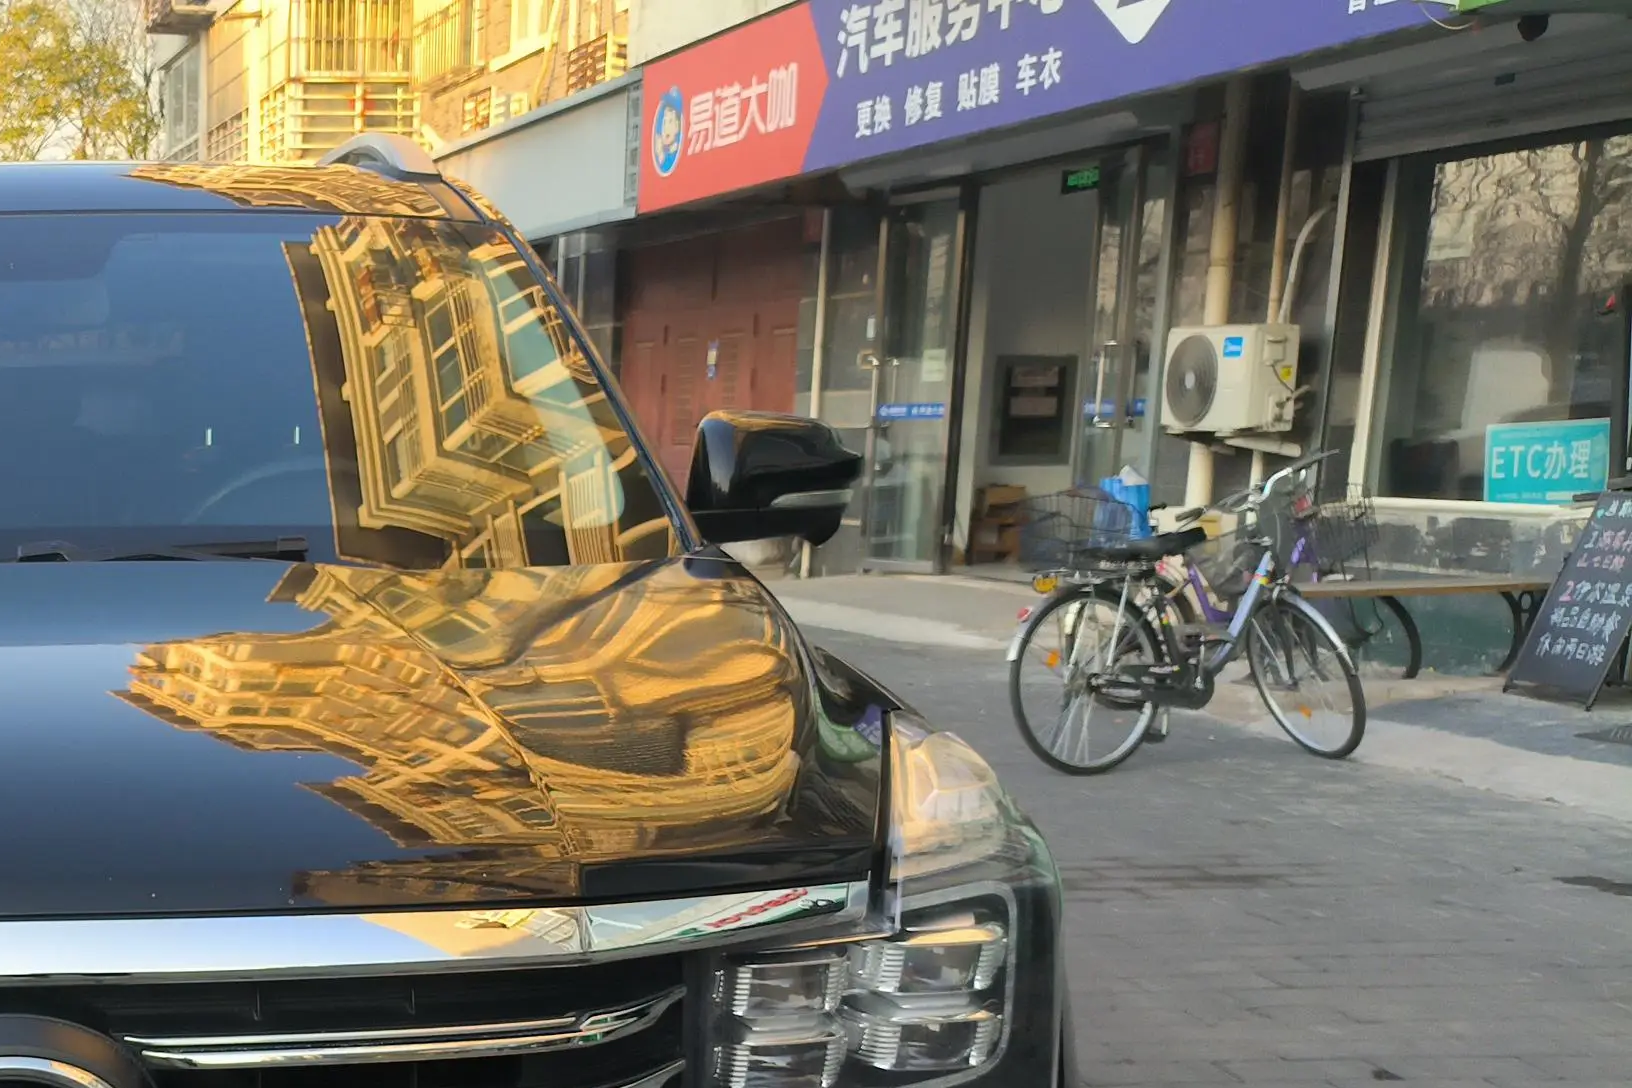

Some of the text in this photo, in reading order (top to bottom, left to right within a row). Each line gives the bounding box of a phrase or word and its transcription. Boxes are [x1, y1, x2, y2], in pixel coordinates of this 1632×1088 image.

[687, 61, 799, 155] 易道大咖
[855, 46, 1063, 138] 更换 修复 贴膜 车衣
[1491, 440, 1591, 479] ETC办理
